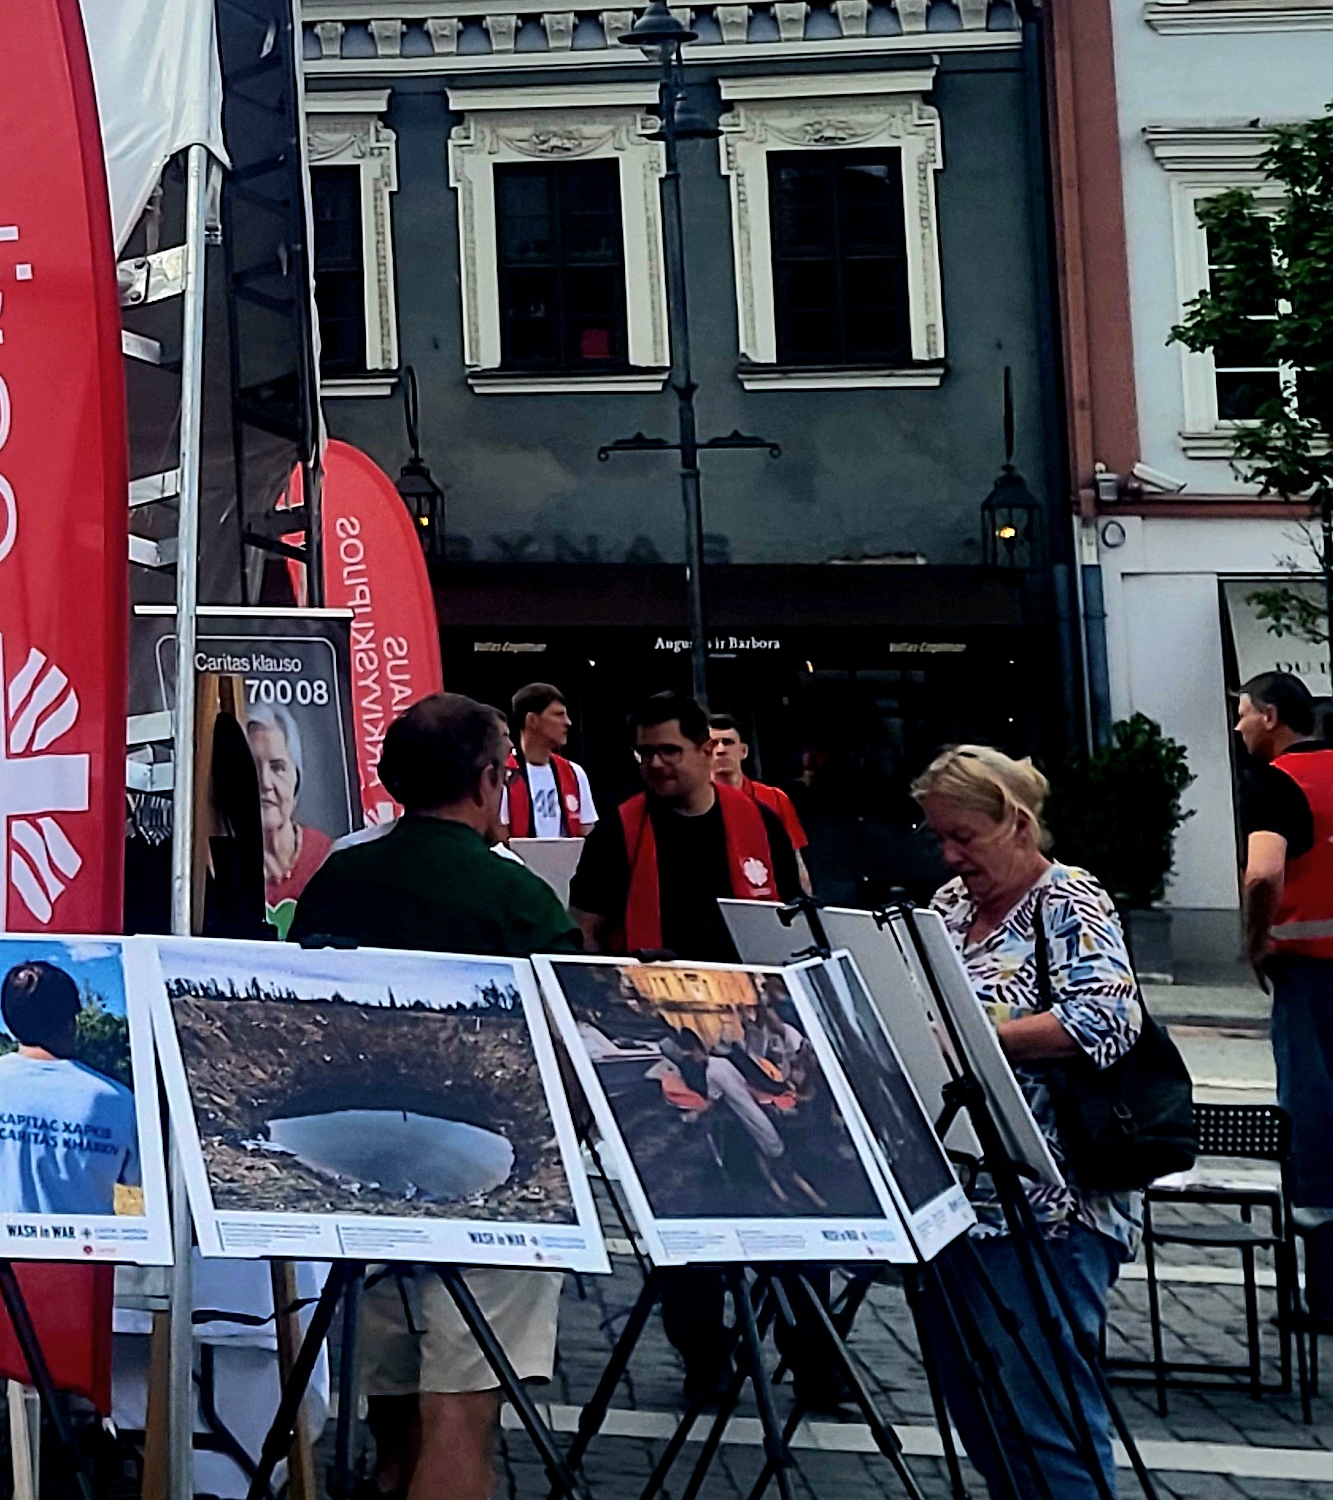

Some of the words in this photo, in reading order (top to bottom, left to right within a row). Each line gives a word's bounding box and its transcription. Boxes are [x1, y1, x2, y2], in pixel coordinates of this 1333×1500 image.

[728, 636, 780, 650] Barbora
[194, 652, 250, 672] Caritas
[253, 653, 302, 673] klauso
[6, 1224, 37, 1238] WASH
[40, 1225, 50, 1239] in
[51, 1225, 76, 1239] WAR
